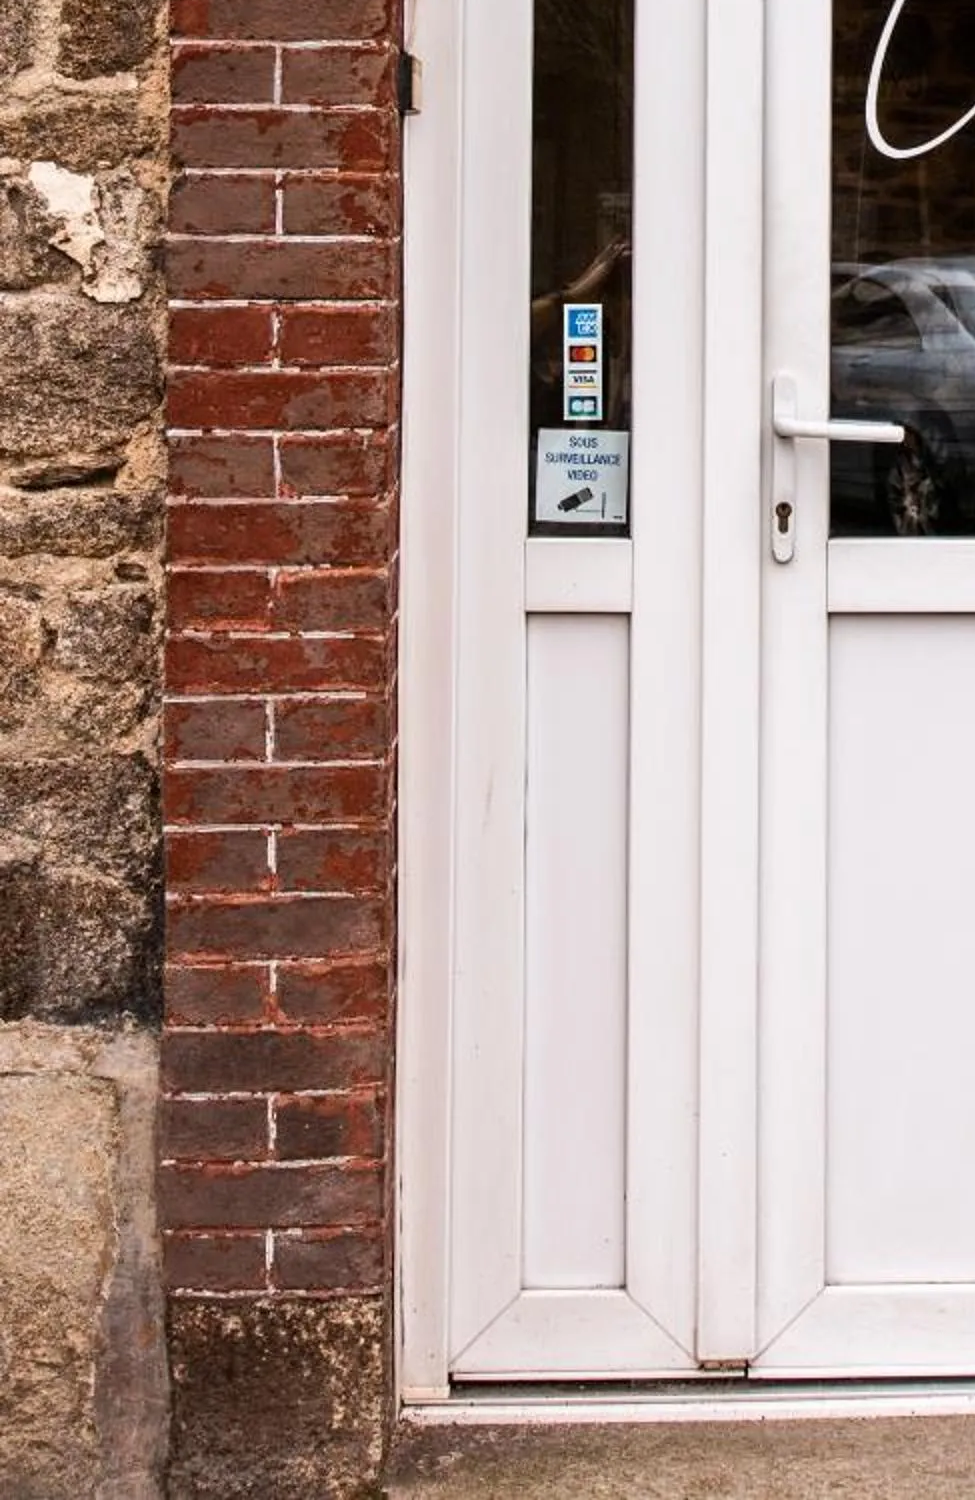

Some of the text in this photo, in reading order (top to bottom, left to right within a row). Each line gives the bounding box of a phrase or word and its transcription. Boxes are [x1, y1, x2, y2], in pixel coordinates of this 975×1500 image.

[573, 375, 595, 384] VISA
[569, 436, 599, 449] SOUS
[545, 452, 622, 467] SURVEILLANCE
